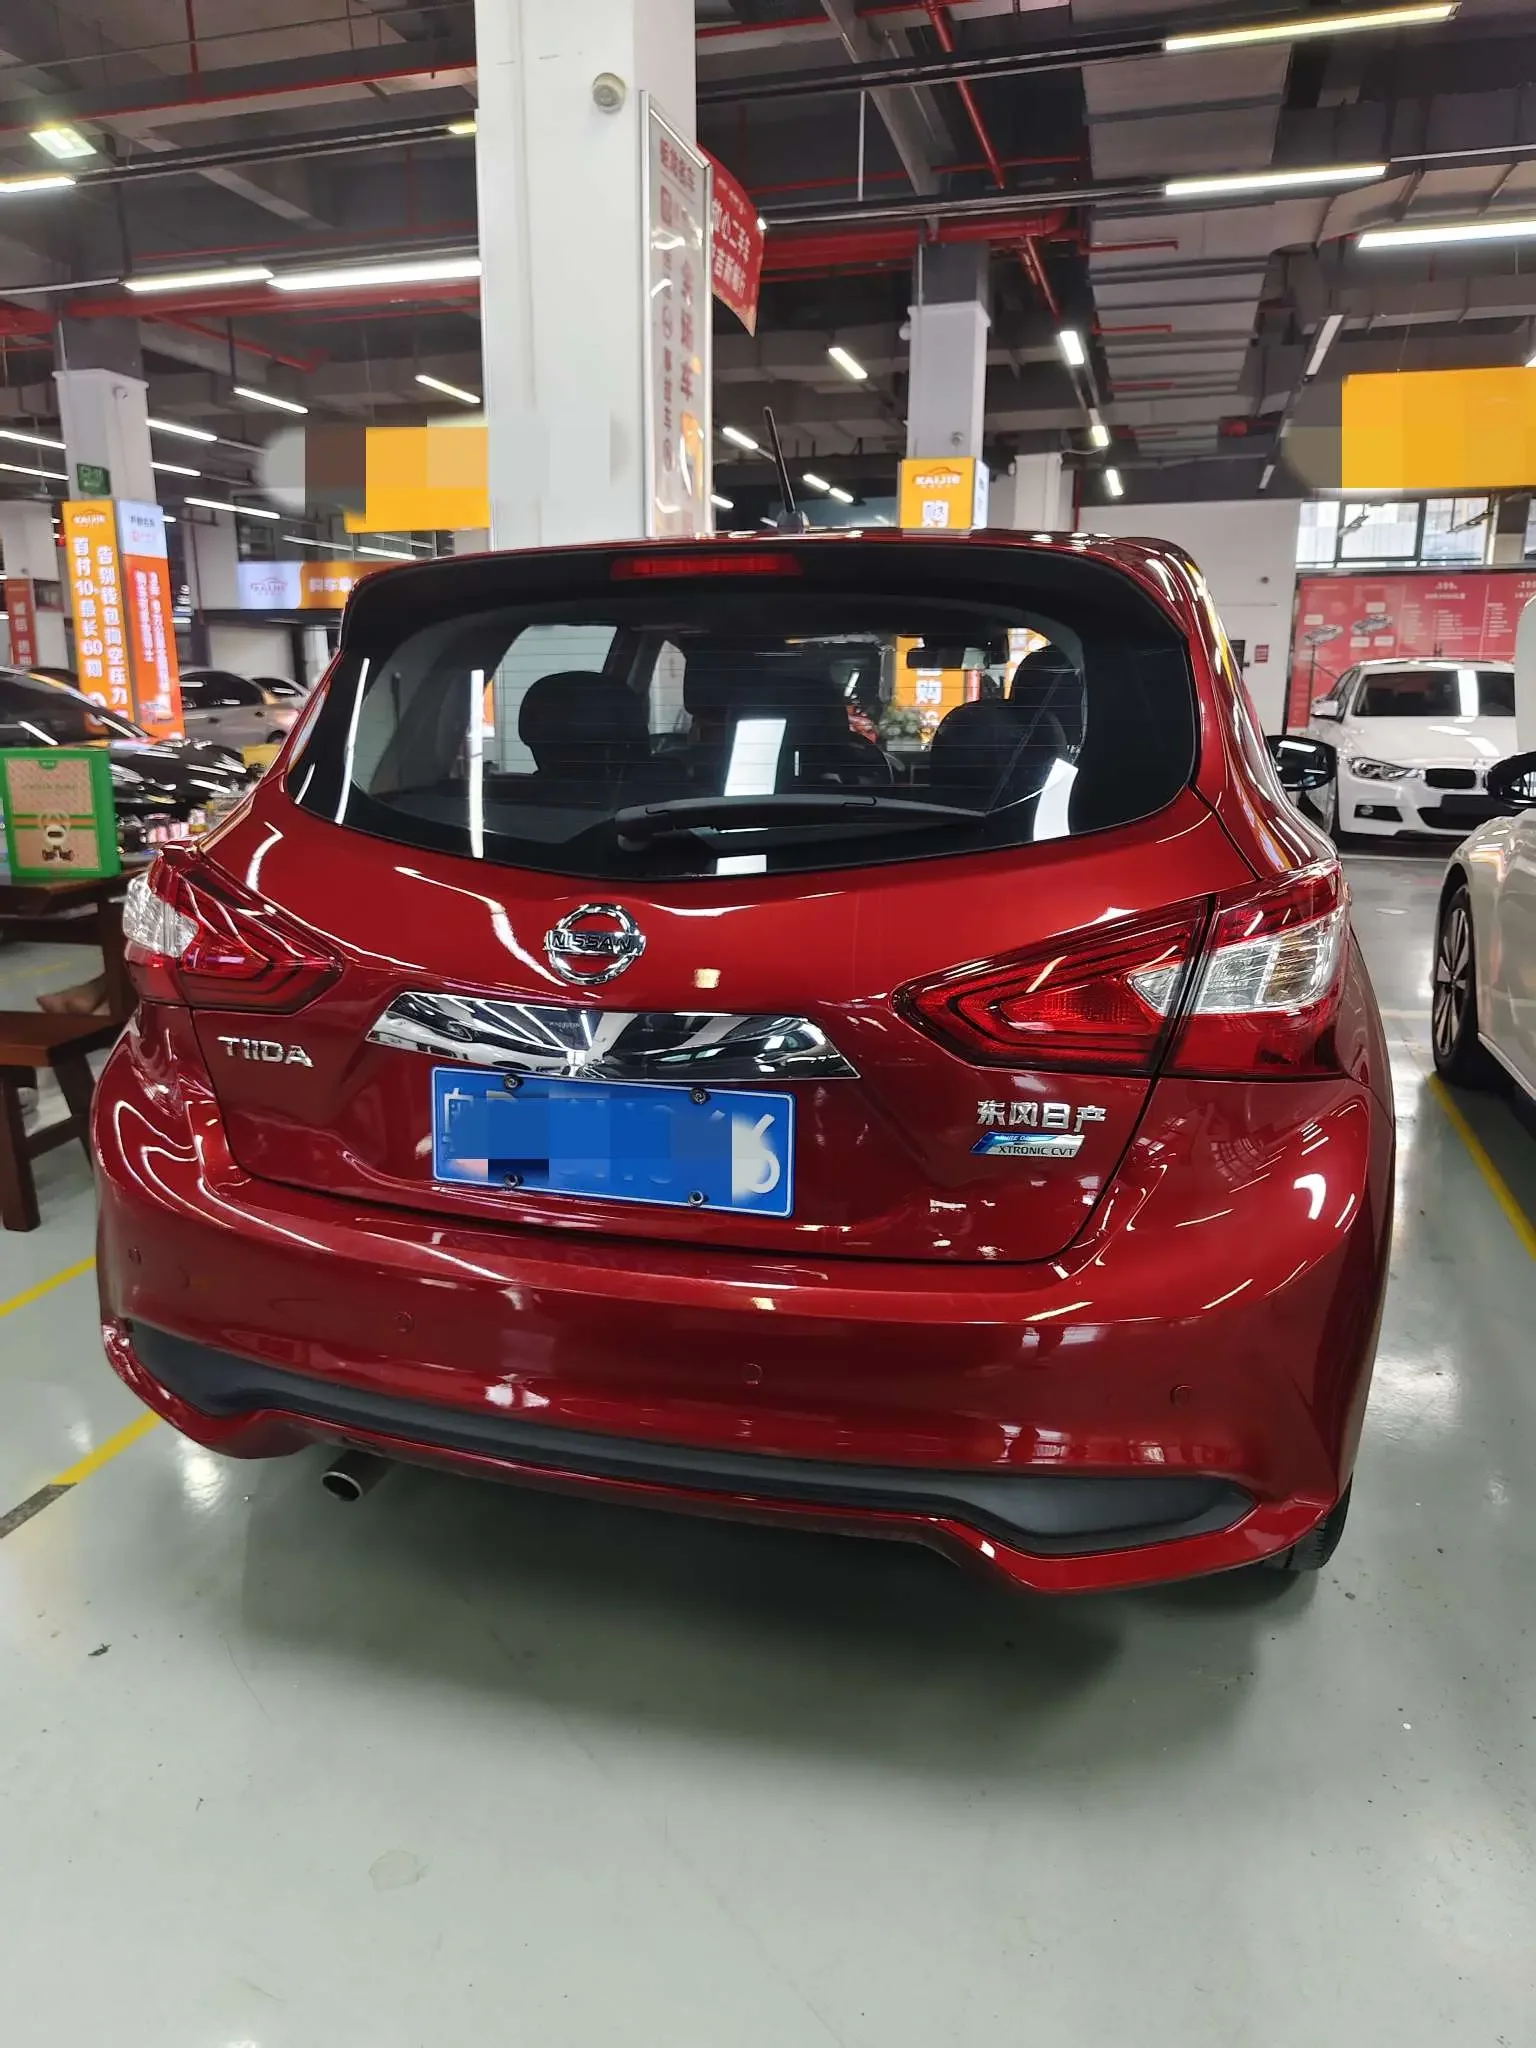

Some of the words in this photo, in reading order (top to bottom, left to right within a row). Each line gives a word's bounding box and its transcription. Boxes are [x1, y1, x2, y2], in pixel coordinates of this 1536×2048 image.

[551, 931, 632, 951] NISSAN
[217, 1036, 314, 1067] TIIDA
[976, 1099, 1107, 1133] 东风日产
[998, 1145, 1048, 1155] XTRONIC
[1051, 1147, 1076, 1157] CVT
